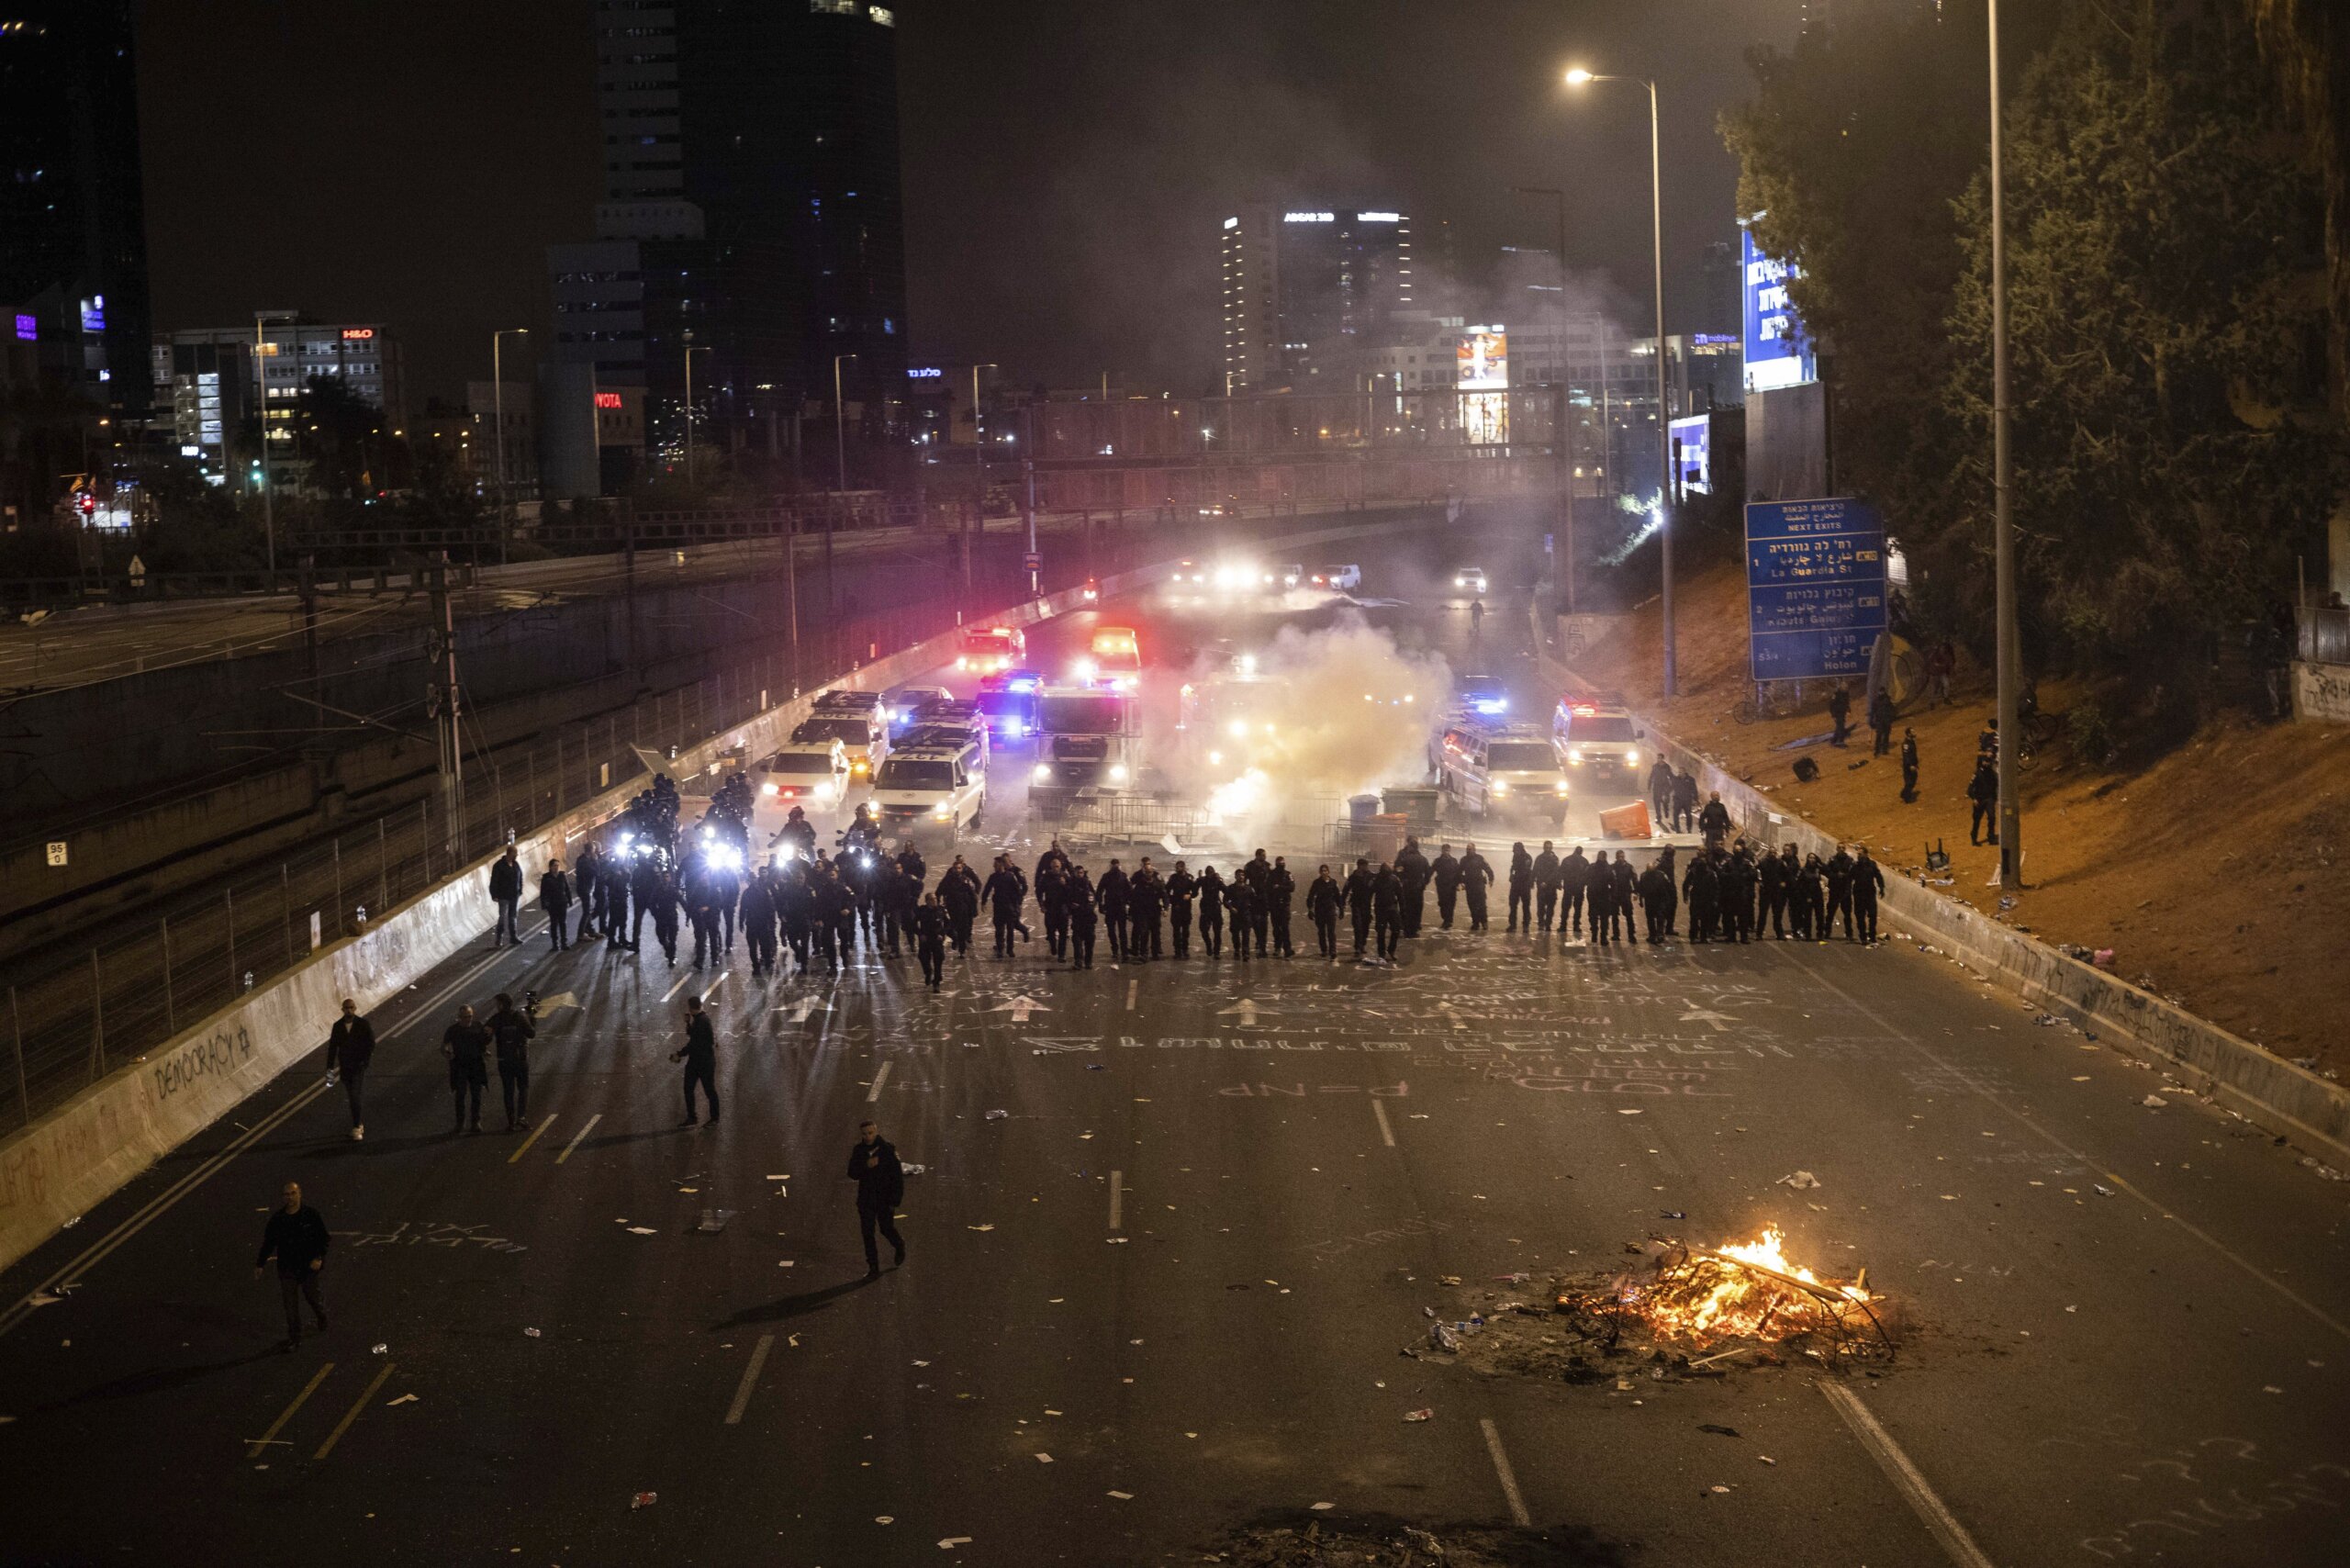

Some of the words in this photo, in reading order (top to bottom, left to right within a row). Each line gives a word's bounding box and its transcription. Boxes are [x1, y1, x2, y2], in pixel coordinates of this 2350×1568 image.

[342, 330, 374, 339] H&O
[1787, 523, 1811, 532] NEXT
[1815, 521, 1842, 531] EXITS
[1814, 541, 1830, 551] לה
[1752, 558, 1760, 567] 1
[1772, 569, 1785, 577] La
[1791, 566, 1835, 577] Guardia
[1840, 565, 1852, 574] St
[1824, 660, 1857, 671] Holon
[50, 845, 63, 854] 95
[54, 855, 61, 864] 0
[155, 1033, 236, 1100] DEMOCRACY
[1219, 1081, 1409, 1097] P=NP
